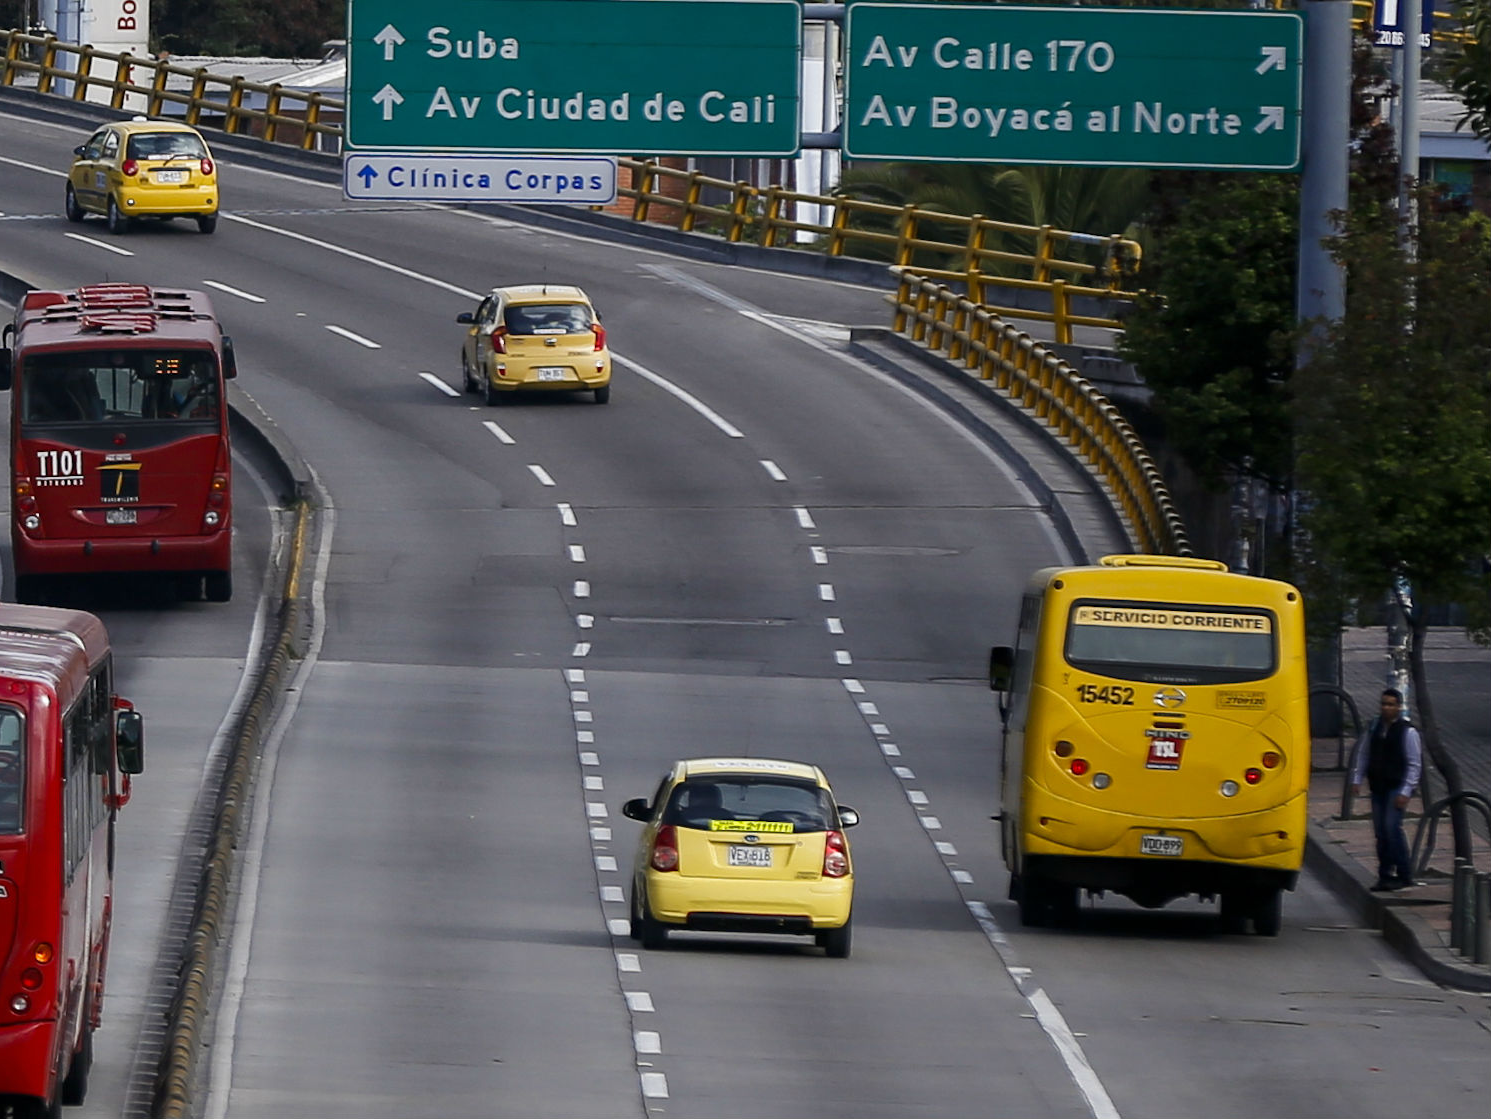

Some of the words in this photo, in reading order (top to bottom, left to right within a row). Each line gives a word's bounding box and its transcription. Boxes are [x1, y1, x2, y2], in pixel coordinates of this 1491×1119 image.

[426, 27, 520, 60] Suba
[862, 35, 918, 69] Av
[934, 37, 1034, 71] Calle
[1046, 40, 1115, 73] 170
[425, 86, 480, 119] Av
[496, 88, 630, 122] Ciudad
[643, 93, 686, 123] de
[699, 91, 776, 124] Cali
[860, 94, 917, 127] Av
[930, 97, 1074, 138] Boyacá
[1087, 105, 1120, 133] al
[1133, 102, 1243, 136] Norte
[387, 166, 491, 189] Clínica
[505, 170, 604, 196] Corpas
[37, 450, 82, 476] T101
[1093, 610, 1168, 624] SERVICIO
[1172, 614, 1265, 629] CORRIENTE
[1076, 684, 1134, 705] 15452
[1145, 730, 1191, 738] HINO
